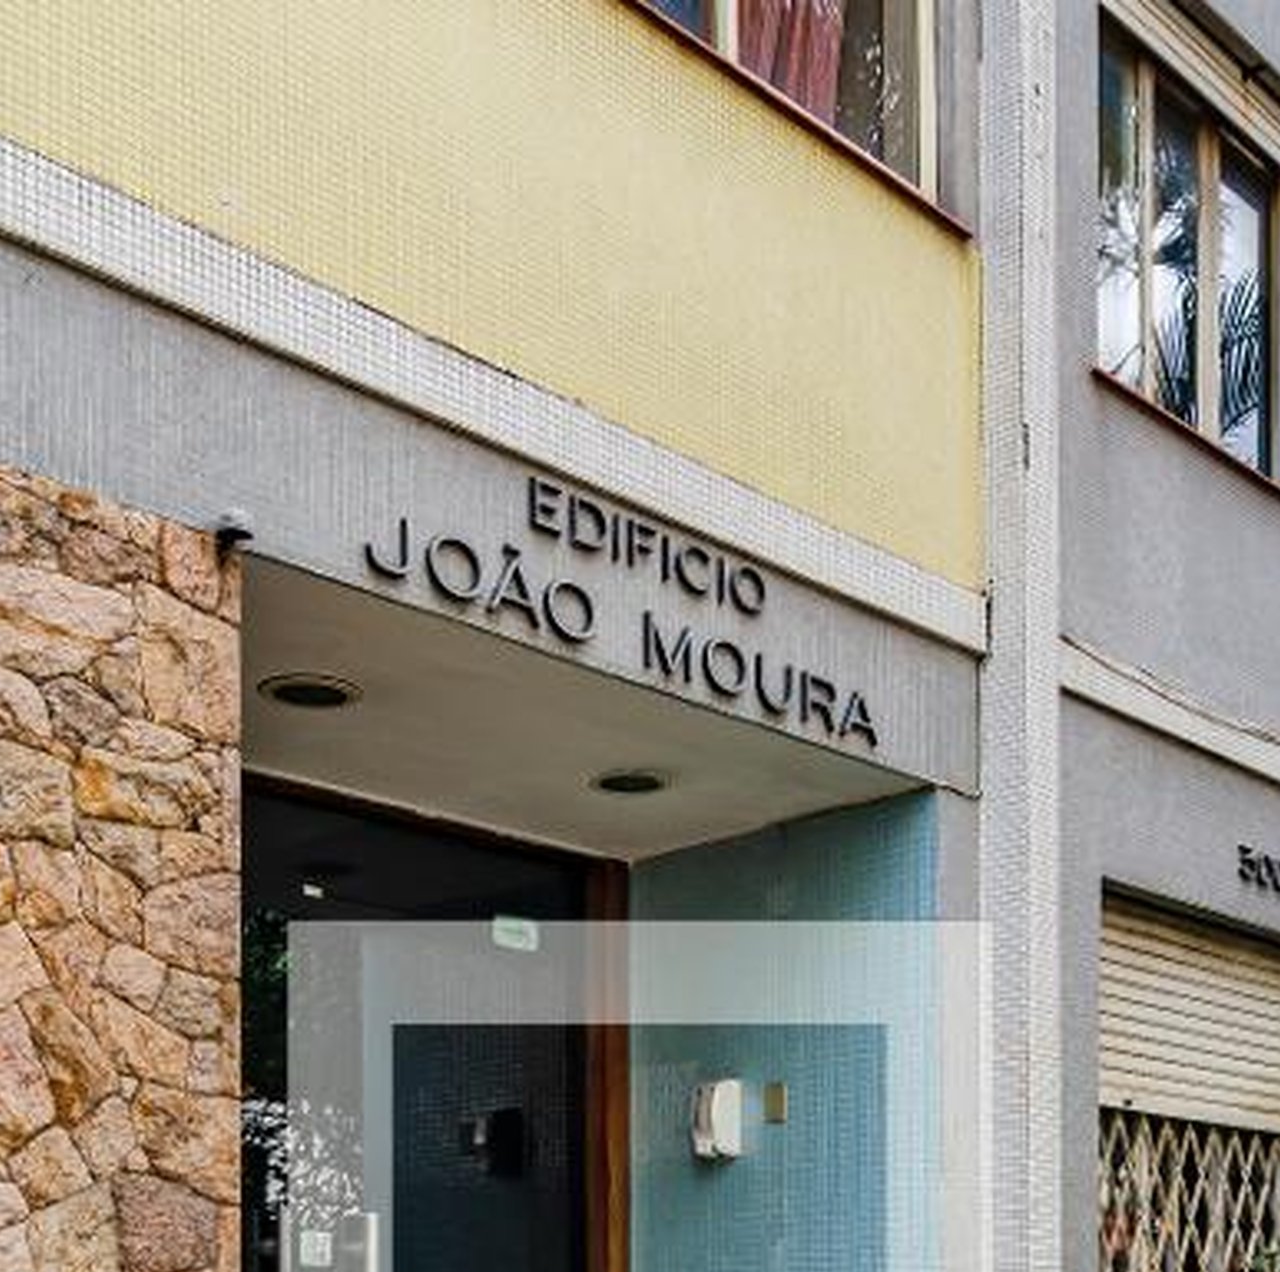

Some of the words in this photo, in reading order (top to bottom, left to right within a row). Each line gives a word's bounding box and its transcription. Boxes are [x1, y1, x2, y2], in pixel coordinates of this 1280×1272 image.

[364, 516, 596, 644] JOÃO
[641, 610, 879, 749] MOURA
[528, 475, 766, 616] EDIFICIO
